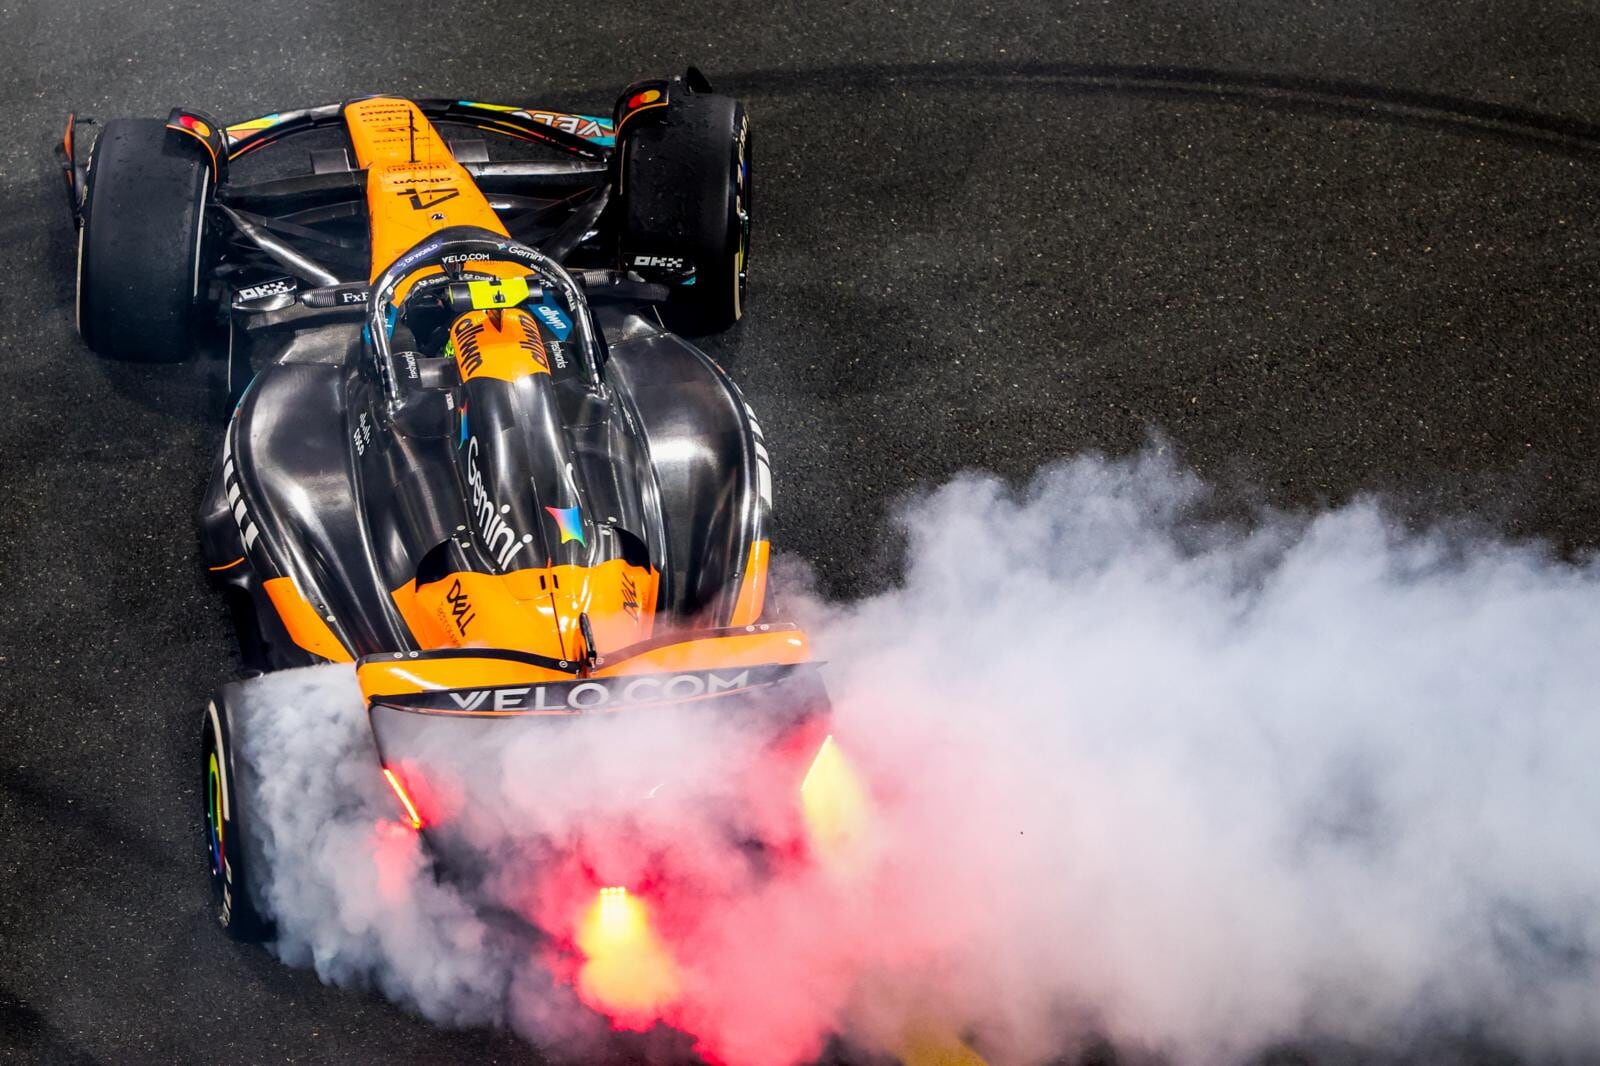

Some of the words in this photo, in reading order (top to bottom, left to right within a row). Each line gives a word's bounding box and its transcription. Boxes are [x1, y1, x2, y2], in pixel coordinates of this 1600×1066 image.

[397, 188, 460, 211] 4
[442, 253, 490, 264] VELO.COM
[508, 246, 545, 262] Gemini
[467, 435, 533, 571] Gemini
[446, 579, 476, 637] DELL
[449, 670, 749, 712] VELO.COM
